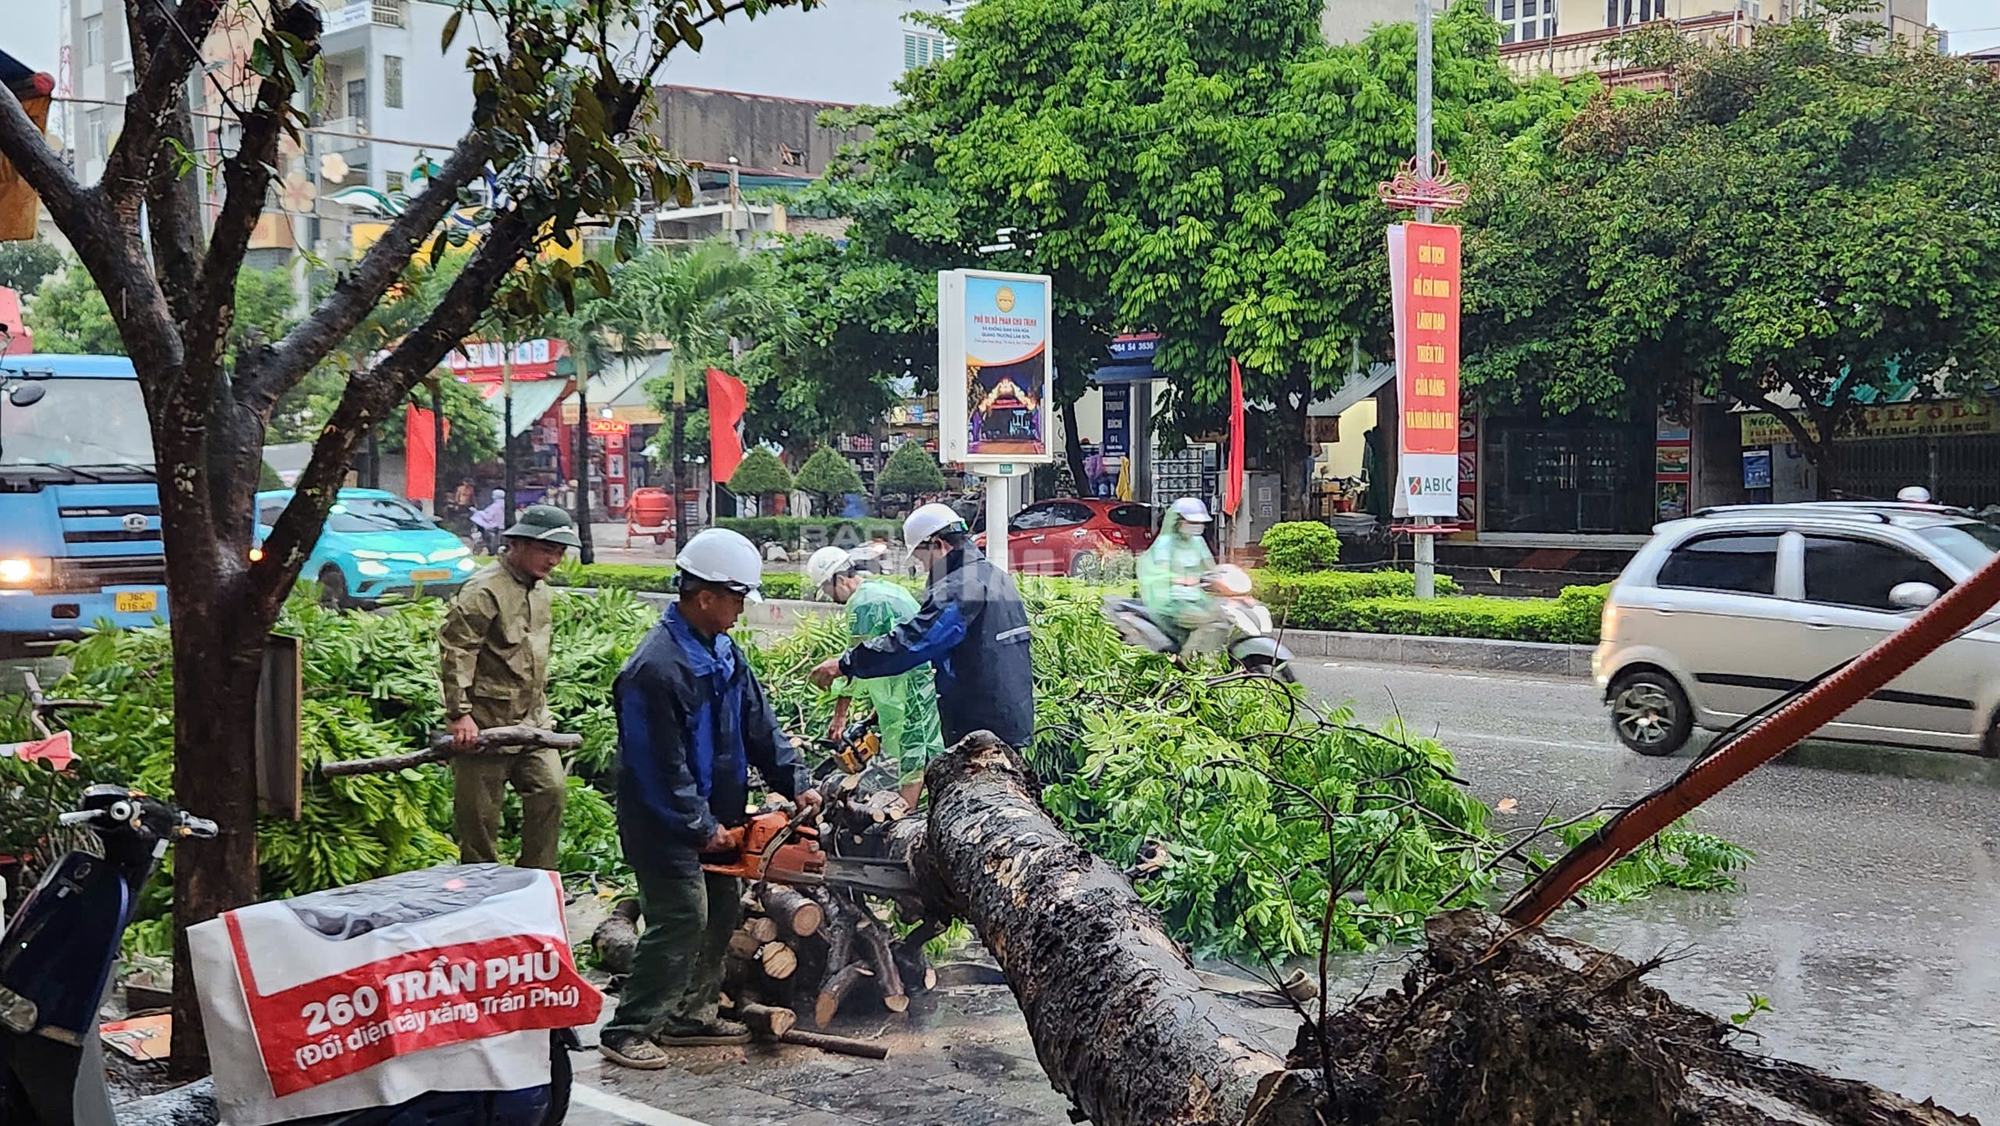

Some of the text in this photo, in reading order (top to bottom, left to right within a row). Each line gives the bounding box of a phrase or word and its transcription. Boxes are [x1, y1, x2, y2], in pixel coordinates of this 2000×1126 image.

[1423, 276, 1433, 296] CHÍ
[1424, 477, 1452, 492] ABIC
[302, 943, 560, 1037] 260 TRẦN PHÚ
[295, 984, 579, 1070] (Đối diện cây xăng Trần Phú)
